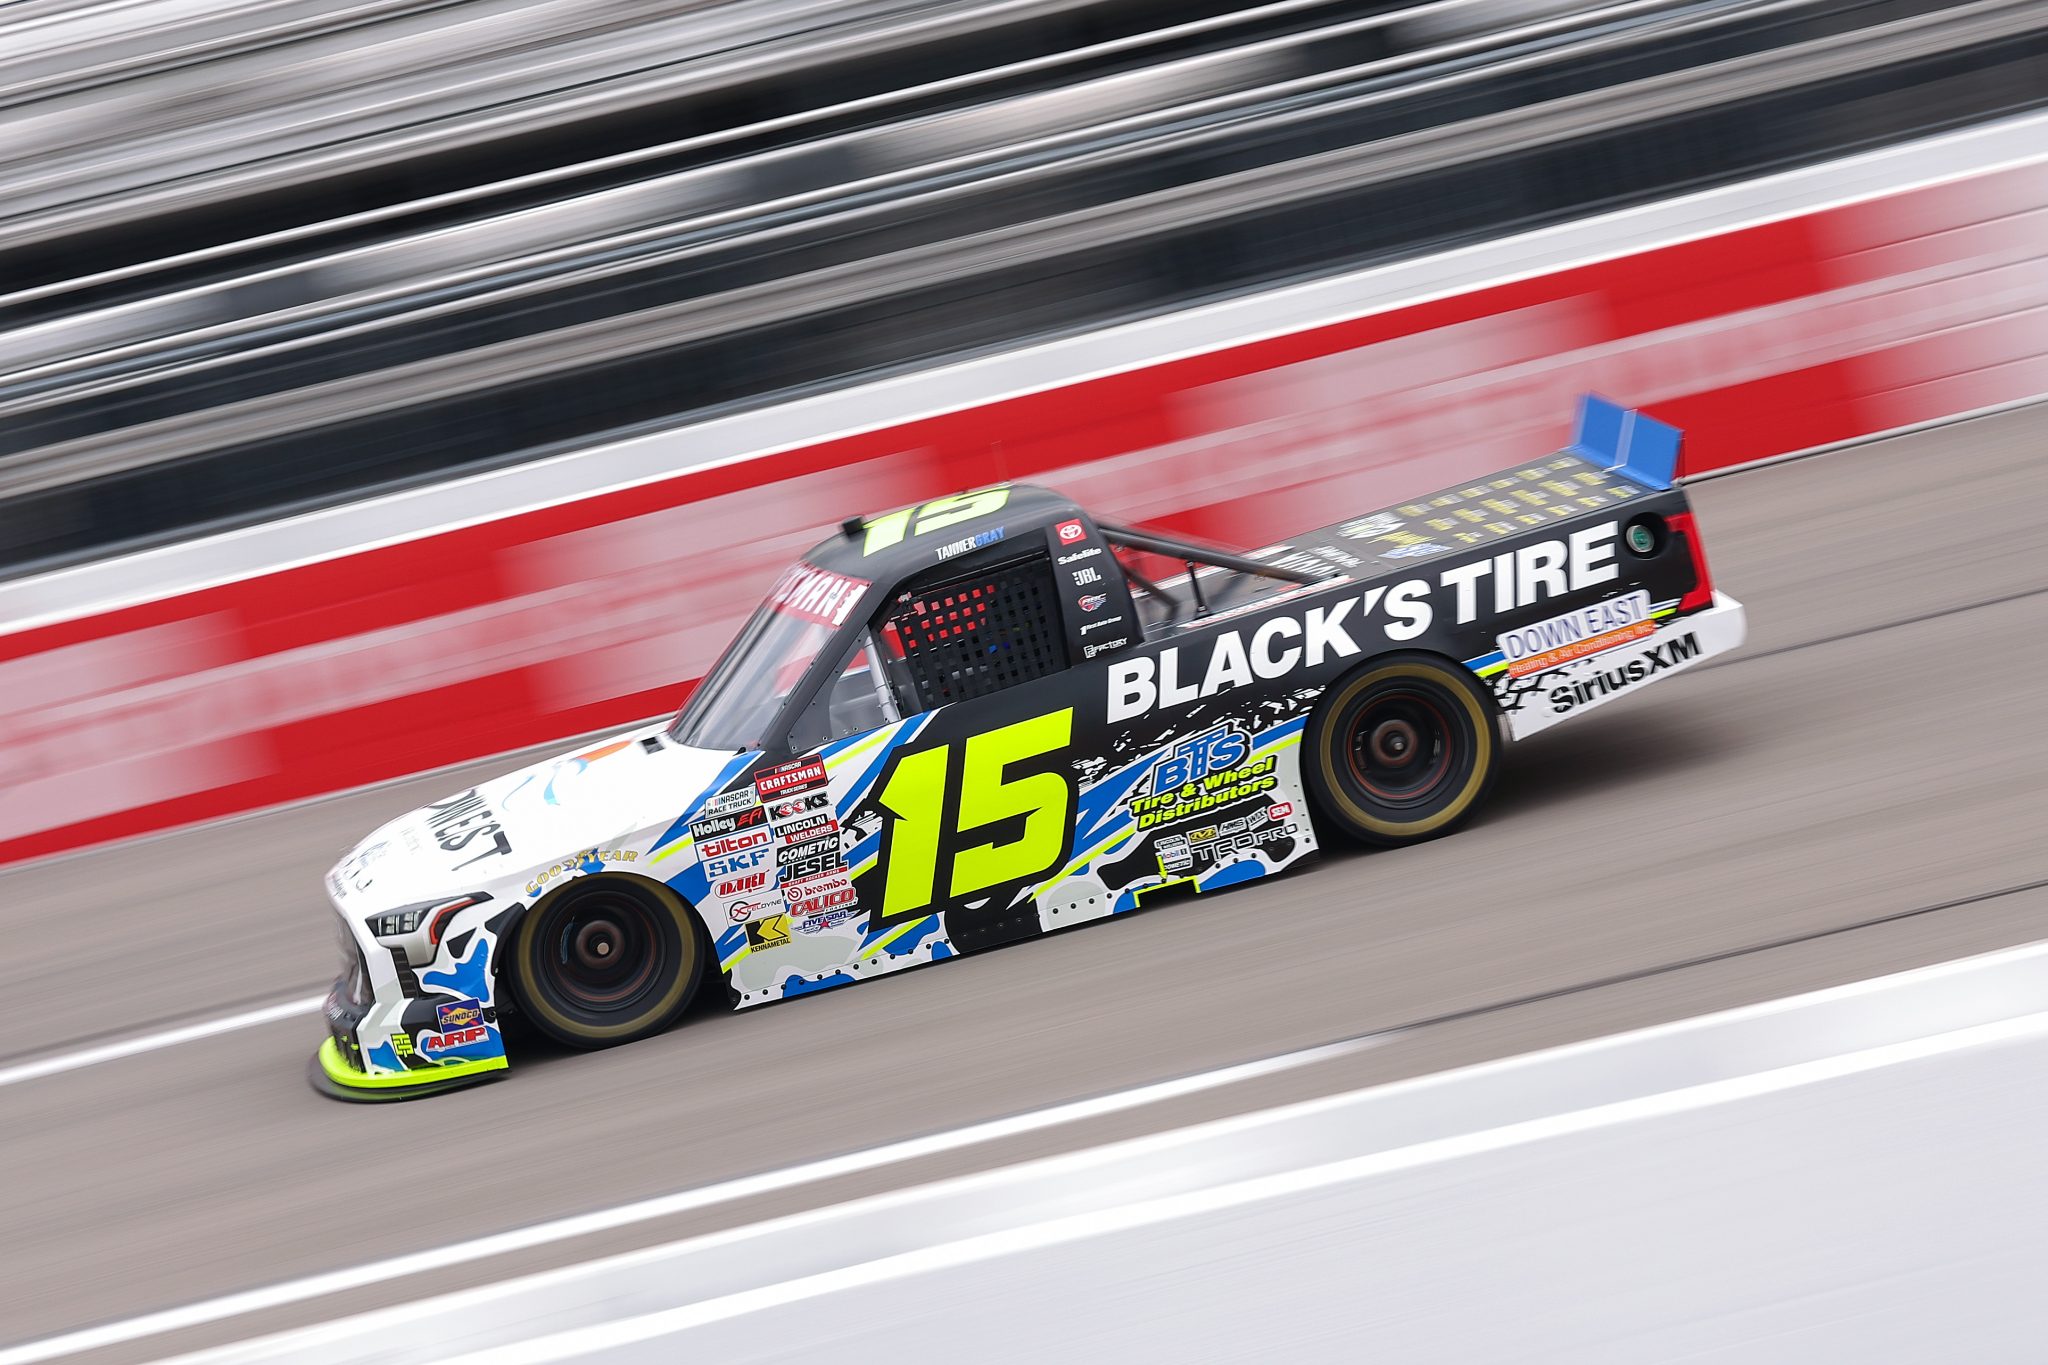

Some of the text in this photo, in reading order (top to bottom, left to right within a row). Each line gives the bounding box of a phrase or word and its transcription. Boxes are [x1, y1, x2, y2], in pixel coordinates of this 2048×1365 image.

[1058, 548, 1102, 565] Safelite
[1072, 567, 1102, 586] JBL
[1107, 521, 1619, 725] BLACK'S TIRE
[1506, 595, 1643, 659] DOWN EAST
[1509, 656, 1548, 674] Heating
[1548, 652, 1559, 663] &
[1560, 648, 1575, 660] Air
[1550, 631, 1703, 714] SiriusXM
[778, 761, 802, 773] NASCAR
[1155, 725, 1246, 794] BTS
[760, 766, 822, 791] CRAFTSMAN
[1131, 757, 1274, 814] Tire & Wheel
[719, 789, 749, 805] NASCAR
[780, 787, 793, 796] TRUCK
[1138, 776, 1275, 829] Distributors
[708, 798, 752, 816] RACE TRUCK
[878, 706, 1074, 918] 15
[692, 818, 736, 838] Holley
[777, 815, 826, 837] LINCOLN
[790, 824, 833, 842] WELDERS
[701, 832, 768, 858] tilton
[778, 836, 839, 863] COMETIC
[708, 848, 769, 878] SKF
[779, 852, 848, 883] JESEL
[804, 879, 848, 896] brembo
[790, 887, 856, 917] CALICO
[803, 917, 823, 930] FIVE
[827, 910, 848, 921] STAR
[750, 937, 791, 954] KENNAMETAL
[441, 1008, 480, 1024] SUNOCO
[427, 1027, 487, 1050] ARP
